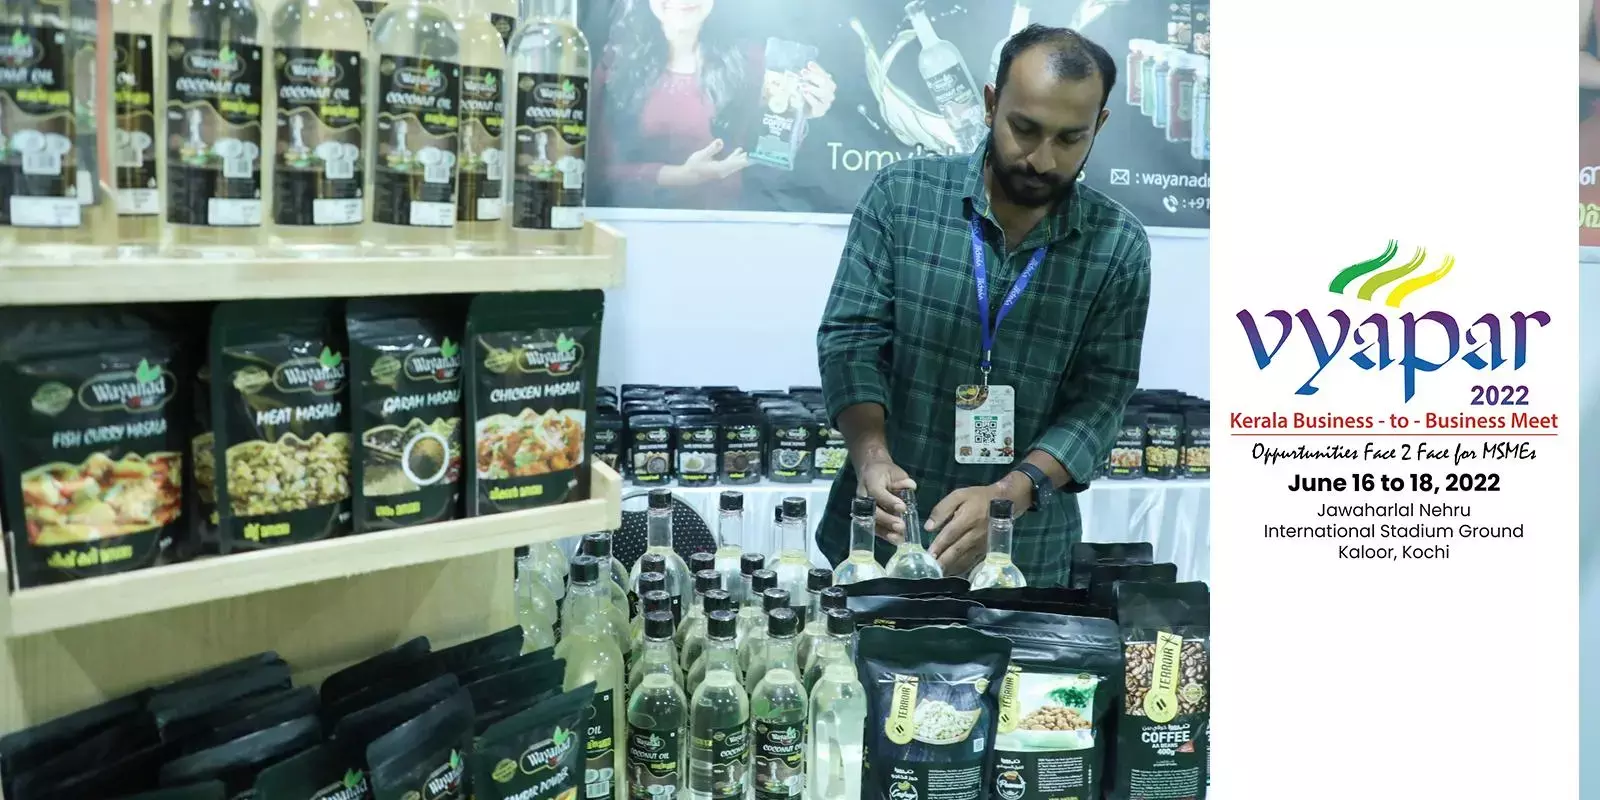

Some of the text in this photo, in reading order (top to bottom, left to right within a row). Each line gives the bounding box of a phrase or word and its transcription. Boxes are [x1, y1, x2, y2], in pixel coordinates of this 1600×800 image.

[526, 348, 576, 367] Wayanad
[284, 362, 345, 385] Wayanad
[92, 378, 166, 403] Wayanad
[490, 380, 581, 402] CHICKEN MASALA
[256, 402, 342, 426] MEAT MASALA
[52, 418, 167, 449] FISH CURRY MASALA
[1159, 647, 1174, 690] TERROIR
[897, 687, 911, 719] TERROIR
[1002, 676, 1014, 709] TERROIR
[587, 725, 603, 736] OIL
[1141, 730, 1191, 743] COFFEE
[527, 736, 571, 767] Wayanad
[763, 744, 793, 753] COCONUT
